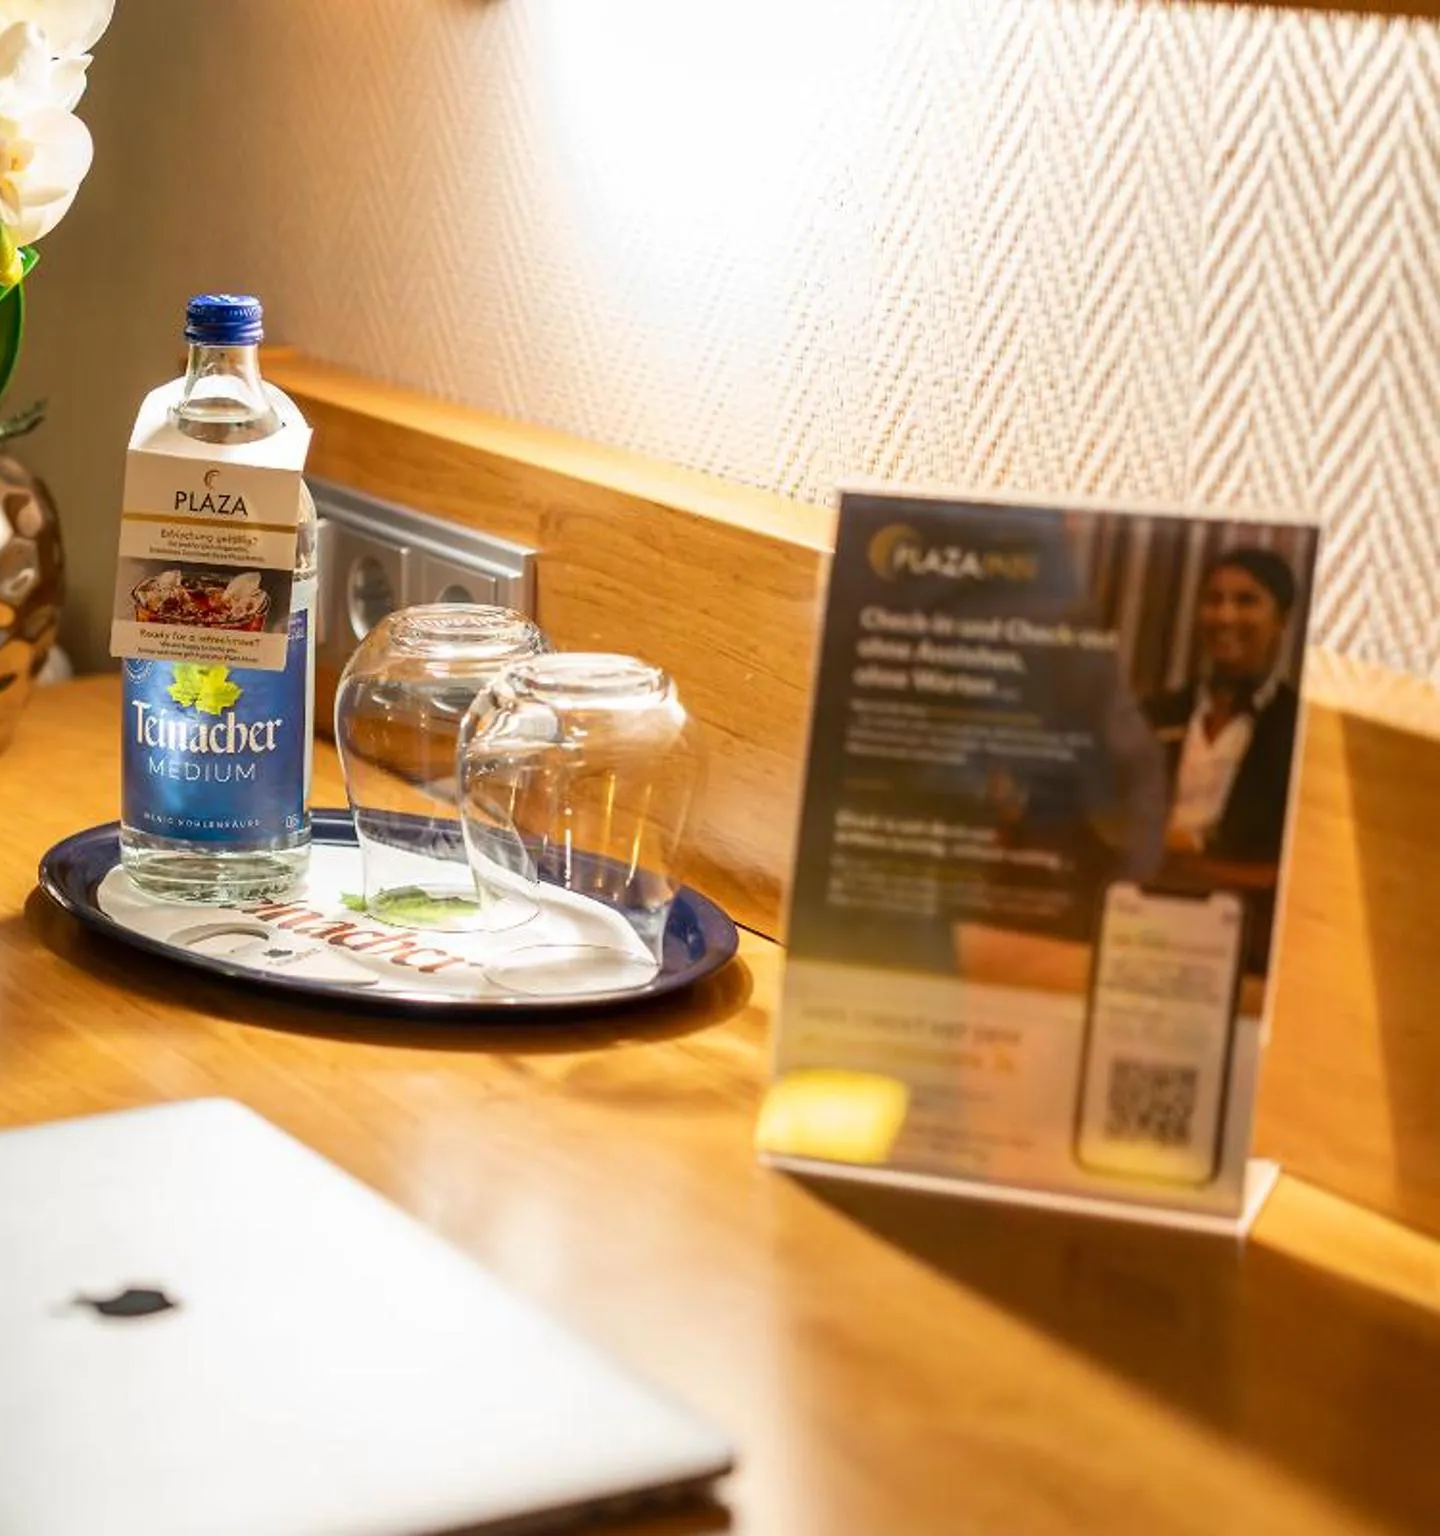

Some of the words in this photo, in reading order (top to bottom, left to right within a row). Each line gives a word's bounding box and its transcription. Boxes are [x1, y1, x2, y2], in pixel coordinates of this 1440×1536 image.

[174, 491, 248, 516] PLAZA
[132, 700, 283, 754] Teinacher
[148, 757, 256, 782] MEDIUM
